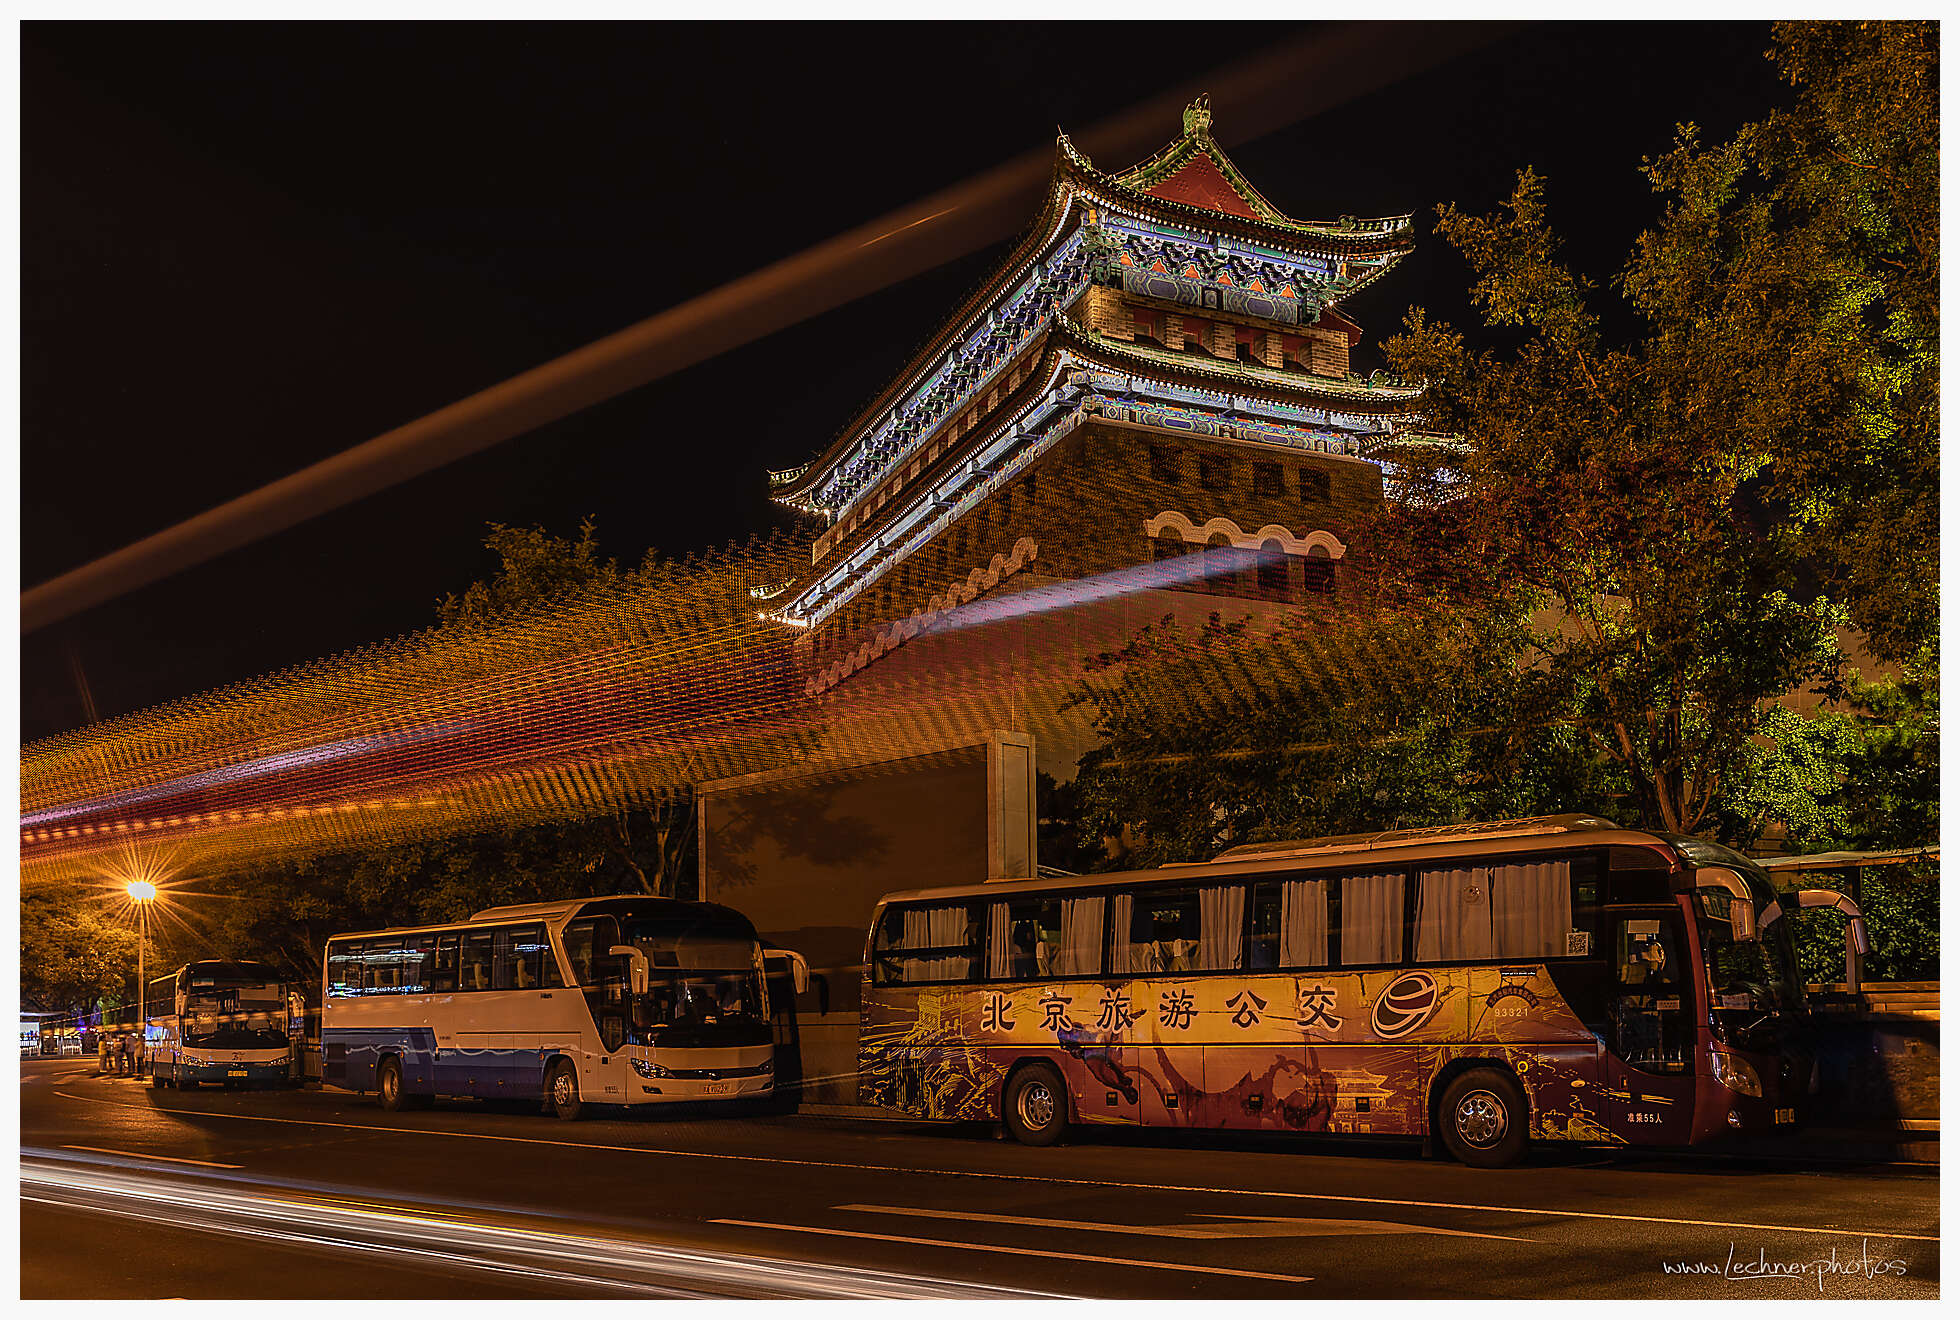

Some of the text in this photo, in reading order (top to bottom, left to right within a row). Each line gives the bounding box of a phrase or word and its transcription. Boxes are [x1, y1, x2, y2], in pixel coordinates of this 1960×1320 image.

[980, 984, 1343, 1033] 北京旅游公交
